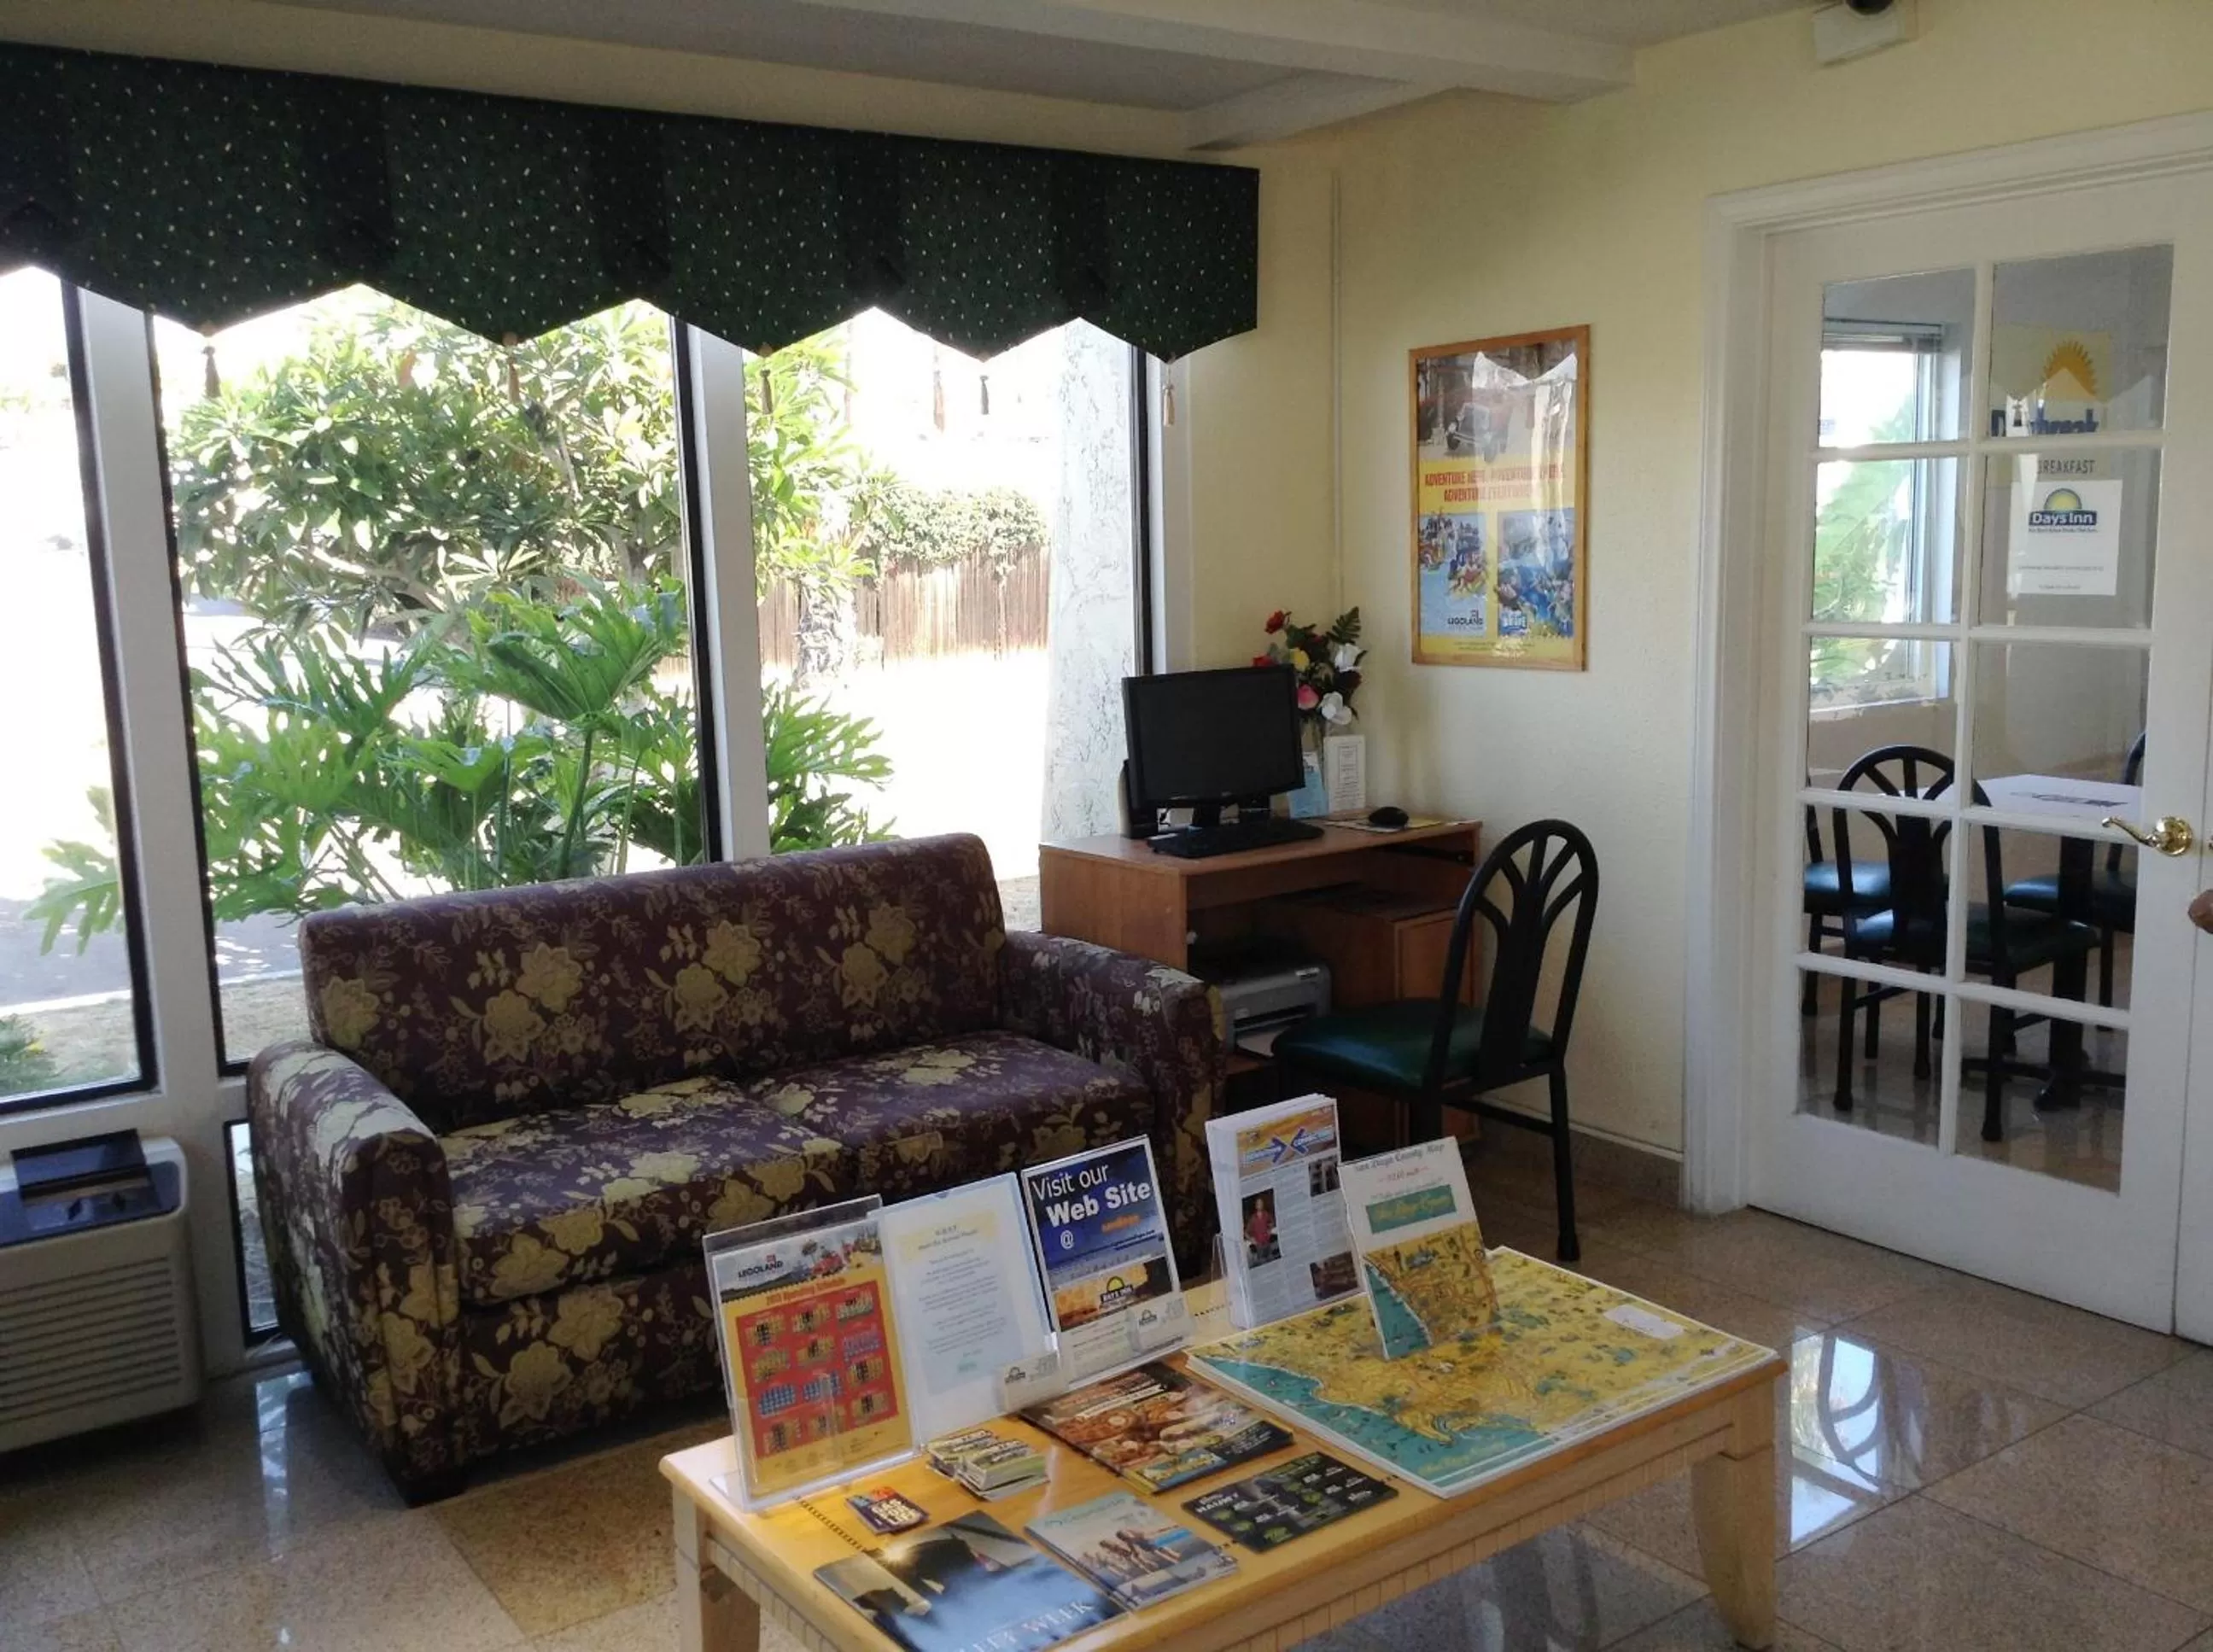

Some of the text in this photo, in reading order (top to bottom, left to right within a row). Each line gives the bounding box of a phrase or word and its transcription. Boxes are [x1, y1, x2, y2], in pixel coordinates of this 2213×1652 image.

[2032, 512, 2093, 525] Days Inn
[1032, 1165, 1109, 1200] Visit our
[1046, 1194, 1100, 1228] Web
[1105, 1182, 1151, 1209] Site
[738, 1259, 784, 1278] LEGOLAND
